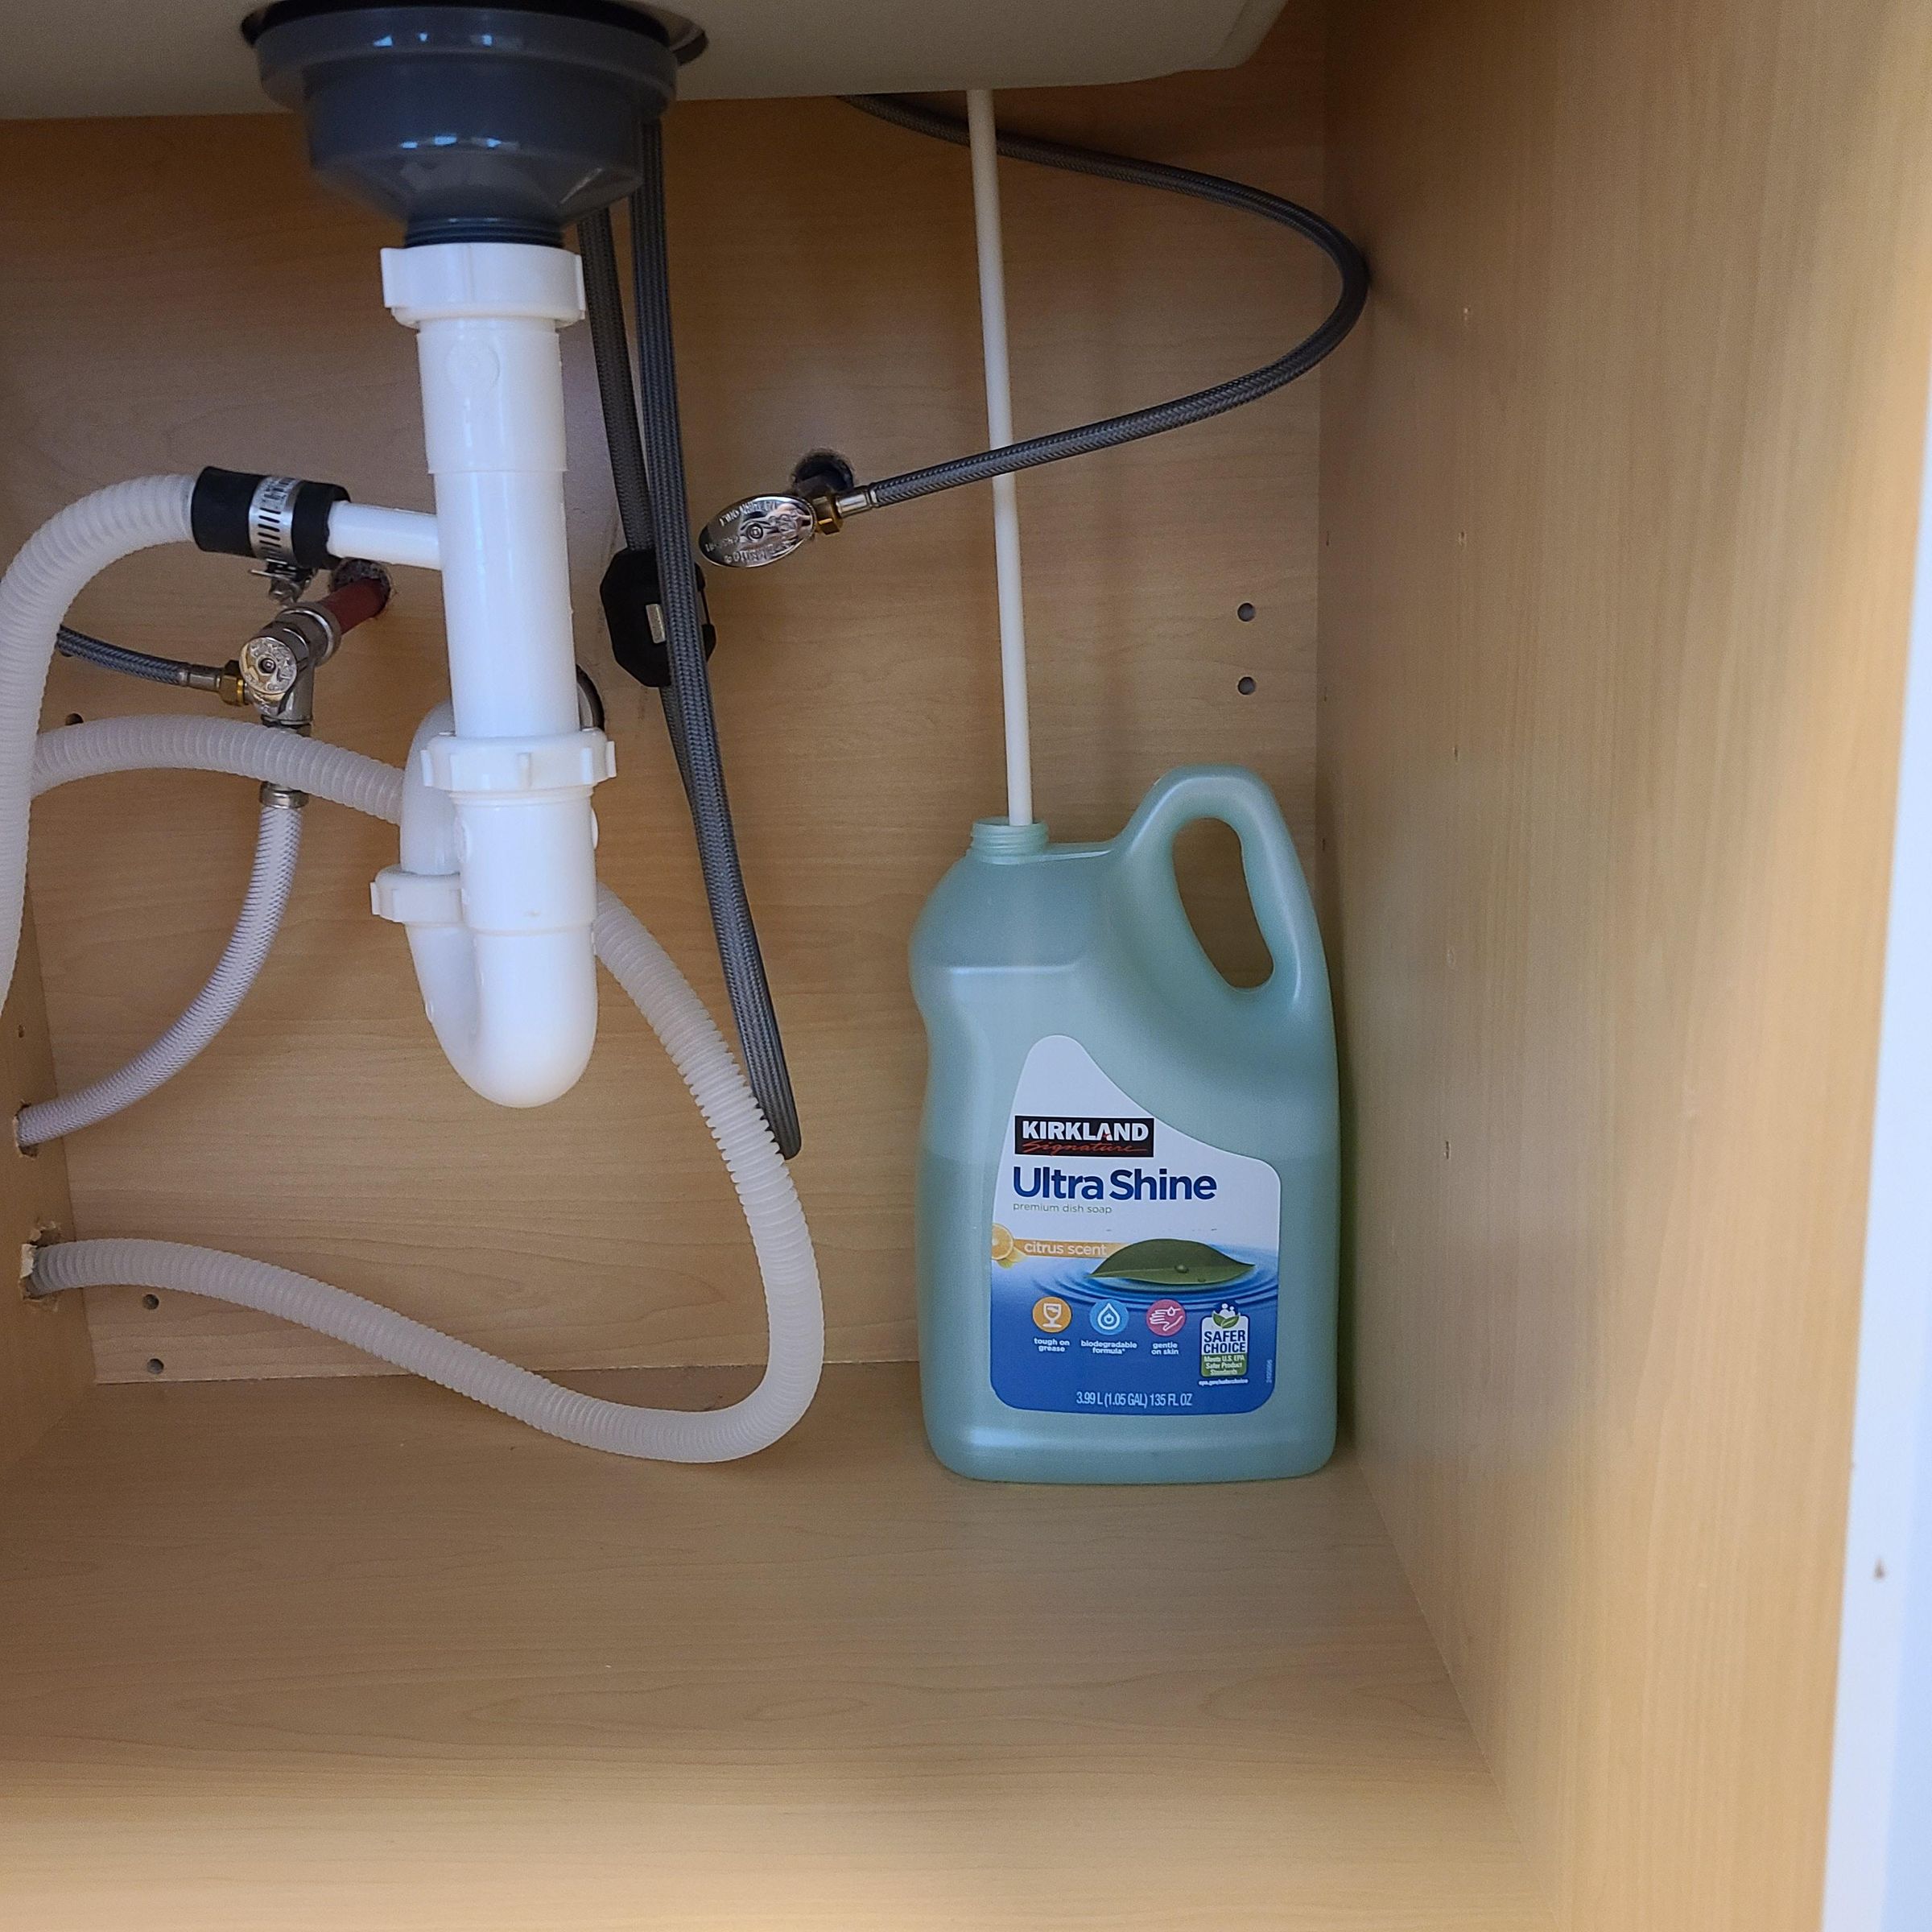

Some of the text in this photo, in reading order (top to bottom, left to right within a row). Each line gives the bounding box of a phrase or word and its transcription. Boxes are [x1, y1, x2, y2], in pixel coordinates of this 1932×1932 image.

[1022, 1121, 1149, 1141] KIRKLAND
[1022, 1139, 1147, 1156] Signature
[1013, 1166, 1217, 1200] Ultra Shine
[1013, 1203, 1113, 1214] premium dish soap
[1024, 1241, 1107, 1256] citrus scent
[1034, 1337, 1058, 1347] tough
[1203, 1330, 1245, 1343] SAFER
[1081, 1340, 1137, 1348] biodegradable
[1153, 1341, 1178, 1349] gentle
[1203, 1342, 1246, 1353] CHOICE
[1076, 1391, 1193, 1409] 3.99 L (1.05 GAL) 135 FL OZ
